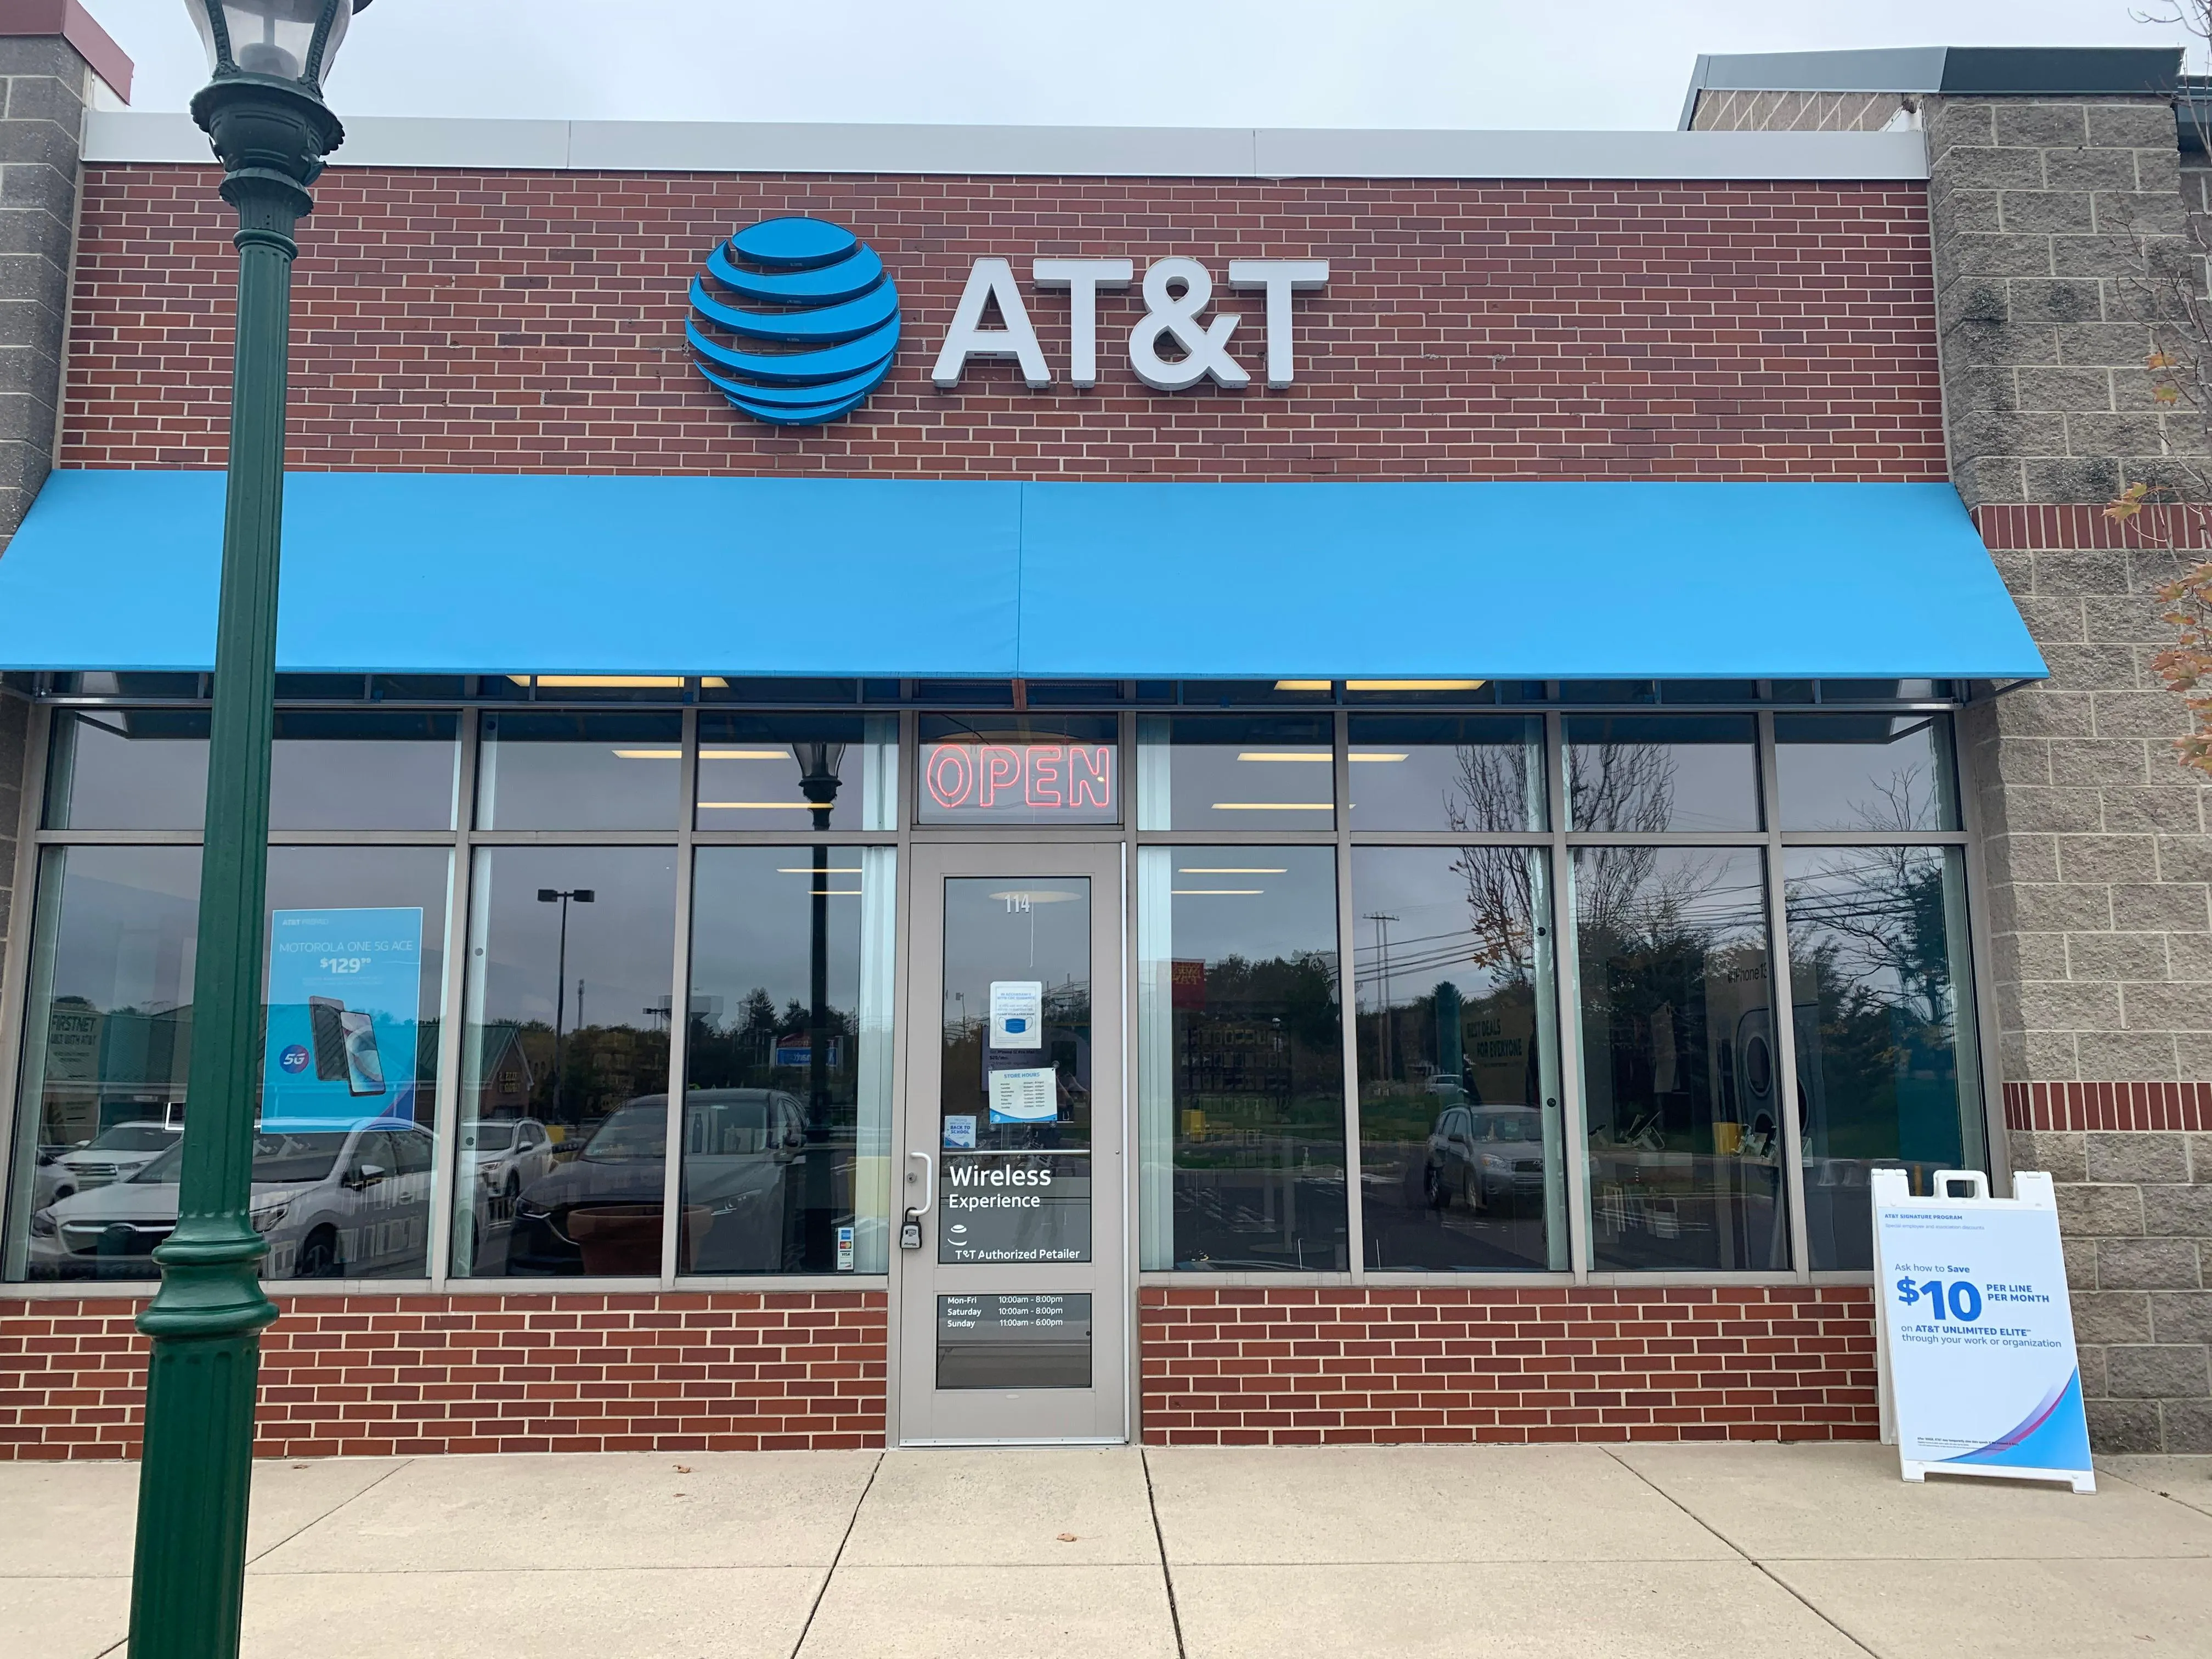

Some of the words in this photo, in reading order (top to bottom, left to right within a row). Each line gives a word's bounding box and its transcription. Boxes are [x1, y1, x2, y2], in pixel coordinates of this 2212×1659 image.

[932, 256, 1329, 391] AT&T
[927, 744, 1110, 808] OPEN
[1005, 894, 1030, 913] 114
[279, 942, 345, 952] MOTOROLA
[347, 941, 371, 951] ONE
[375, 940, 388, 951] 5G
[391, 940, 413, 950] ACE
[1482, 1018, 1501, 1037] DEALS
[1477, 1041, 1489, 1057] FOR
[1489, 1038, 1522, 1057] EVERYONE
[283, 1053, 307, 1065] 5G
[950, 1164, 1051, 1186] Wireless
[949, 1194, 1040, 1211] Experience
[978, 1249, 1036, 1259] Authorized
[1914, 1263, 1932, 1272] how
[1036, 1296, 1063, 1304] 8:00pm
[1897, 1276, 1982, 1322] $10
[2010, 1294, 2050, 1303] MONTH
[947, 1308, 981, 1317] Saturday
[1036, 1307, 1063, 1316] 8:00pm
[947, 1319, 975, 1328] Sunday
[1036, 1319, 1063, 1327] 6:00pm
[1943, 1326, 1997, 1335] UNLIMITED
[1902, 1334, 1938, 1344] through
[1941, 1336, 1961, 1345] your
[1964, 1336, 1988, 1345] work
[2002, 1339, 2062, 1348] organization
